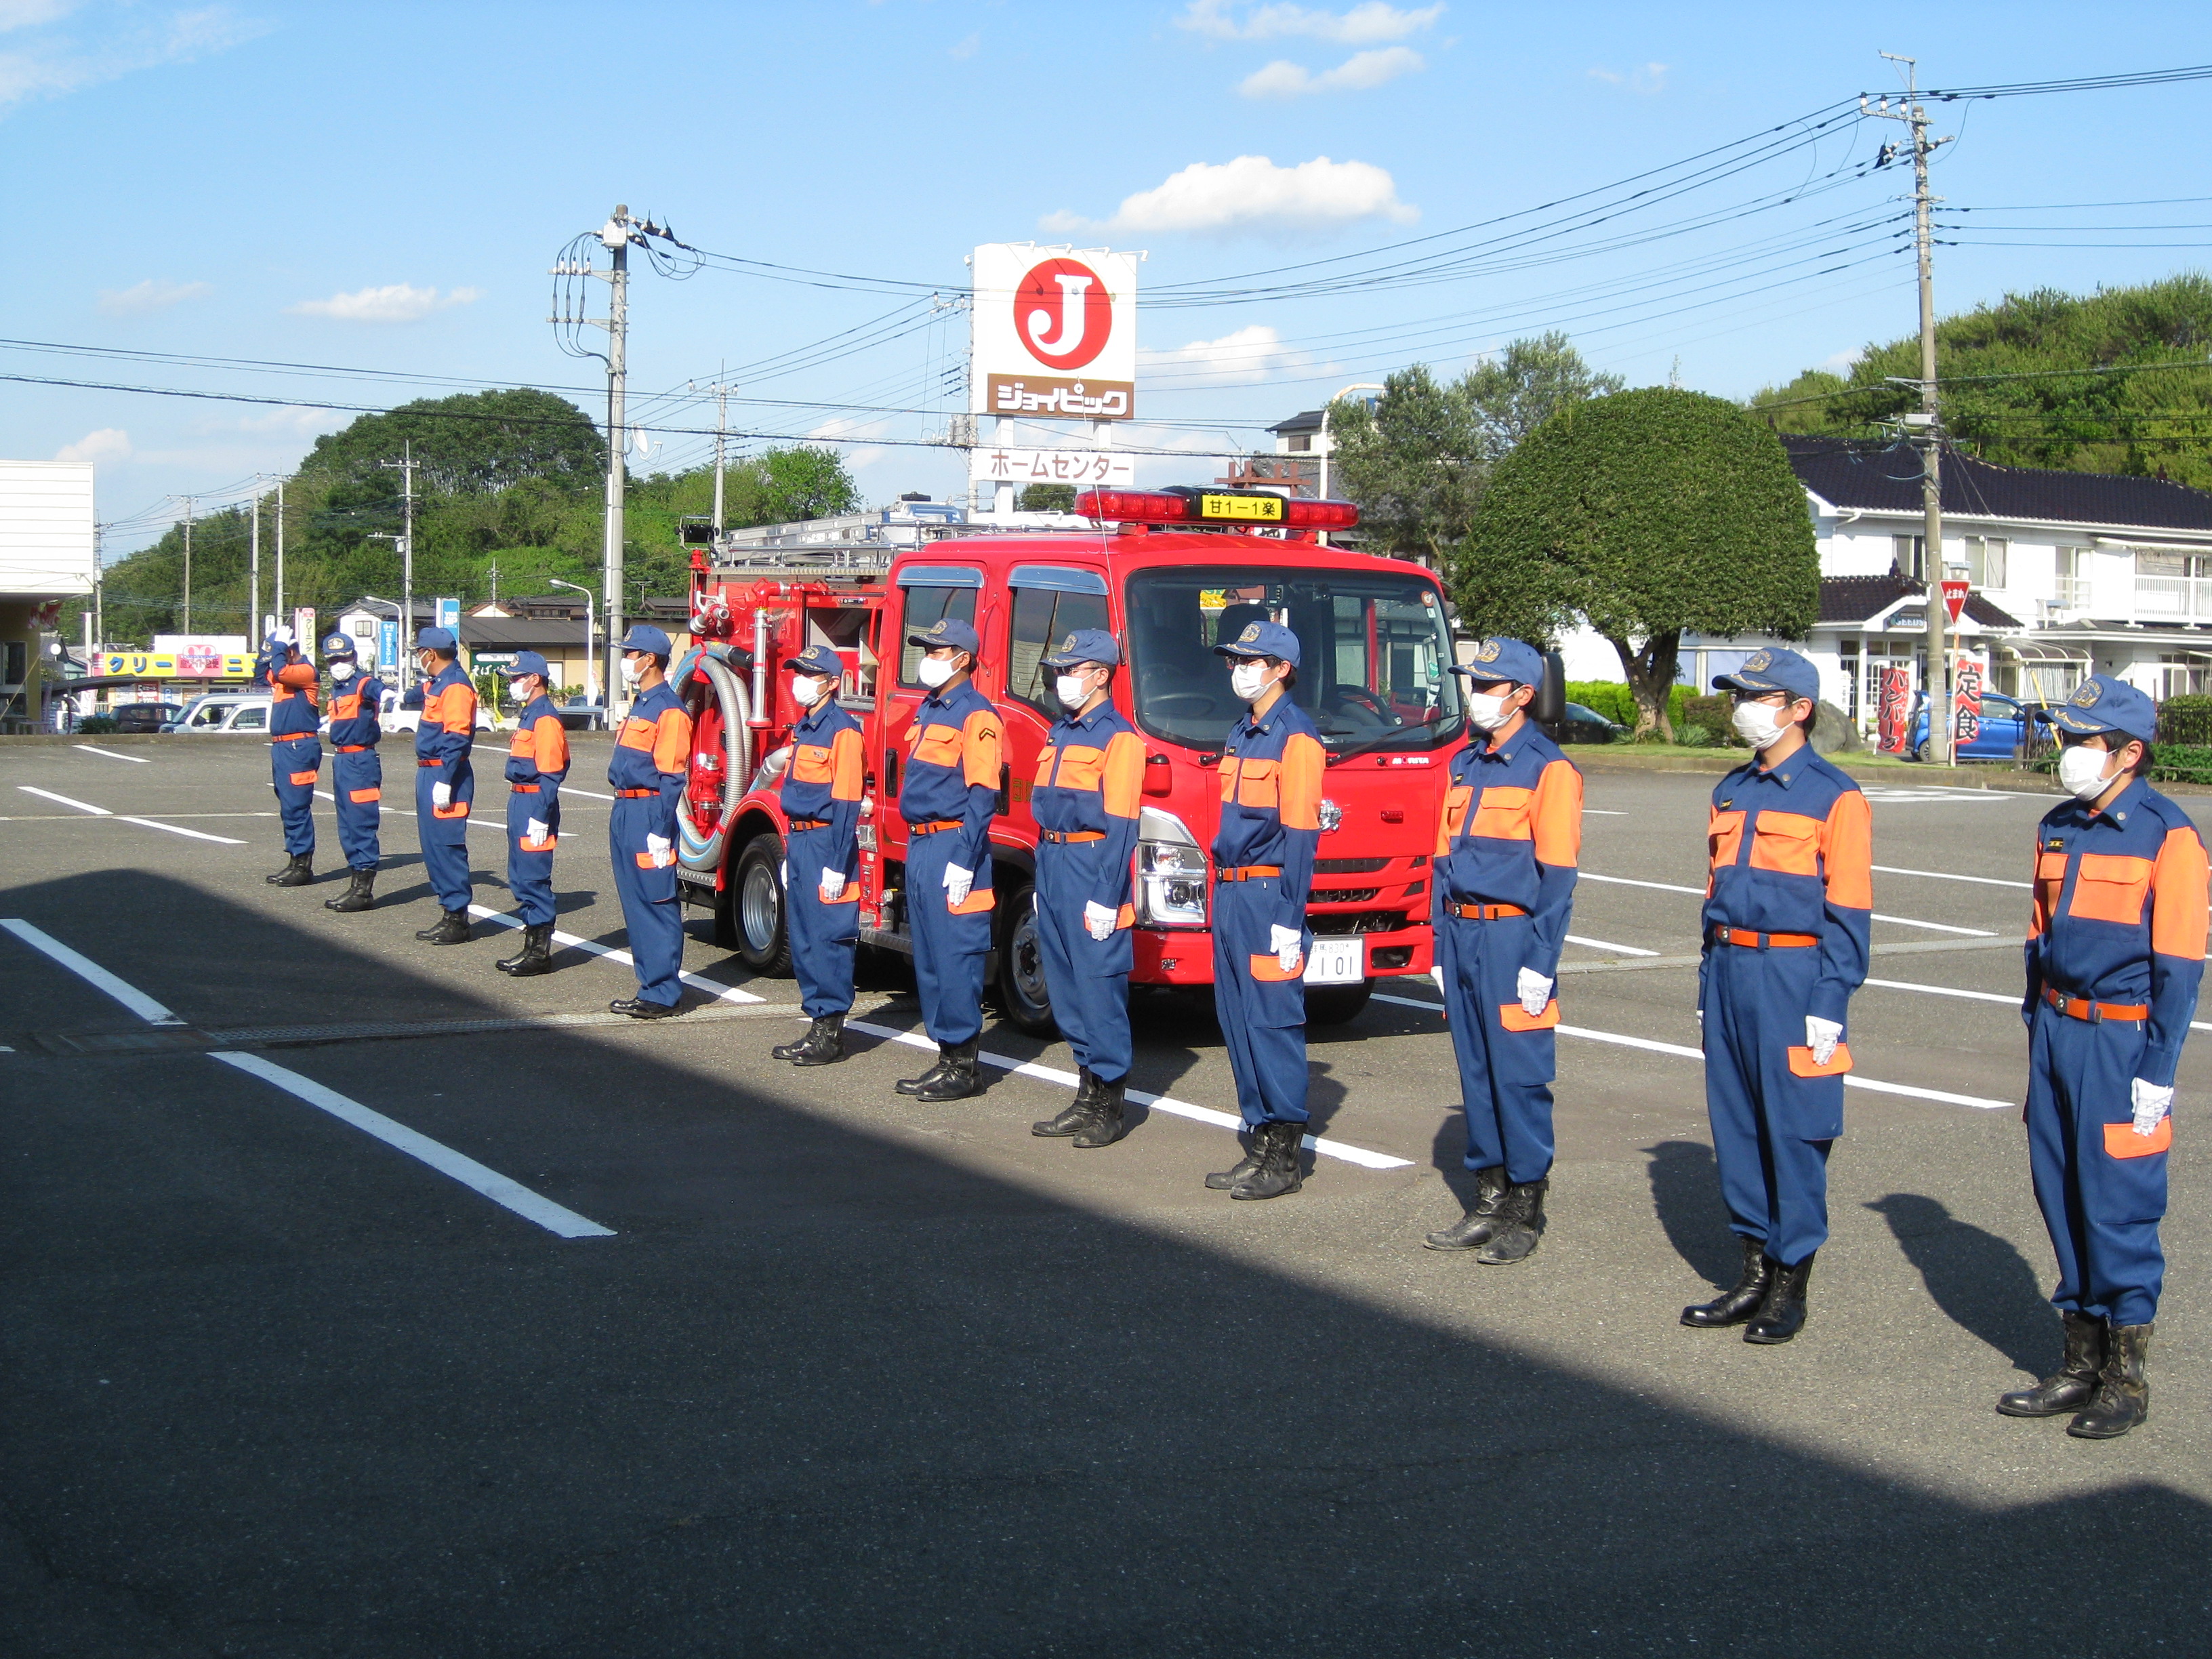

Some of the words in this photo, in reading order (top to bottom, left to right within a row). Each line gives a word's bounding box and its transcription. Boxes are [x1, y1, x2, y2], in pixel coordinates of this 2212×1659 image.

[1027, 274, 1093, 356] J
[997, 382, 1128, 415] ジョイピック
[991, 450, 1130, 480] ホームセンター
[1946, 588, 1965, 599] 止まれ
[305, 617, 314, 652] クリーニング
[1883, 670, 1904, 750] ハンバーグ
[1957, 665, 1982, 740] 定食
[1391, 754, 1429, 764] MORITA
